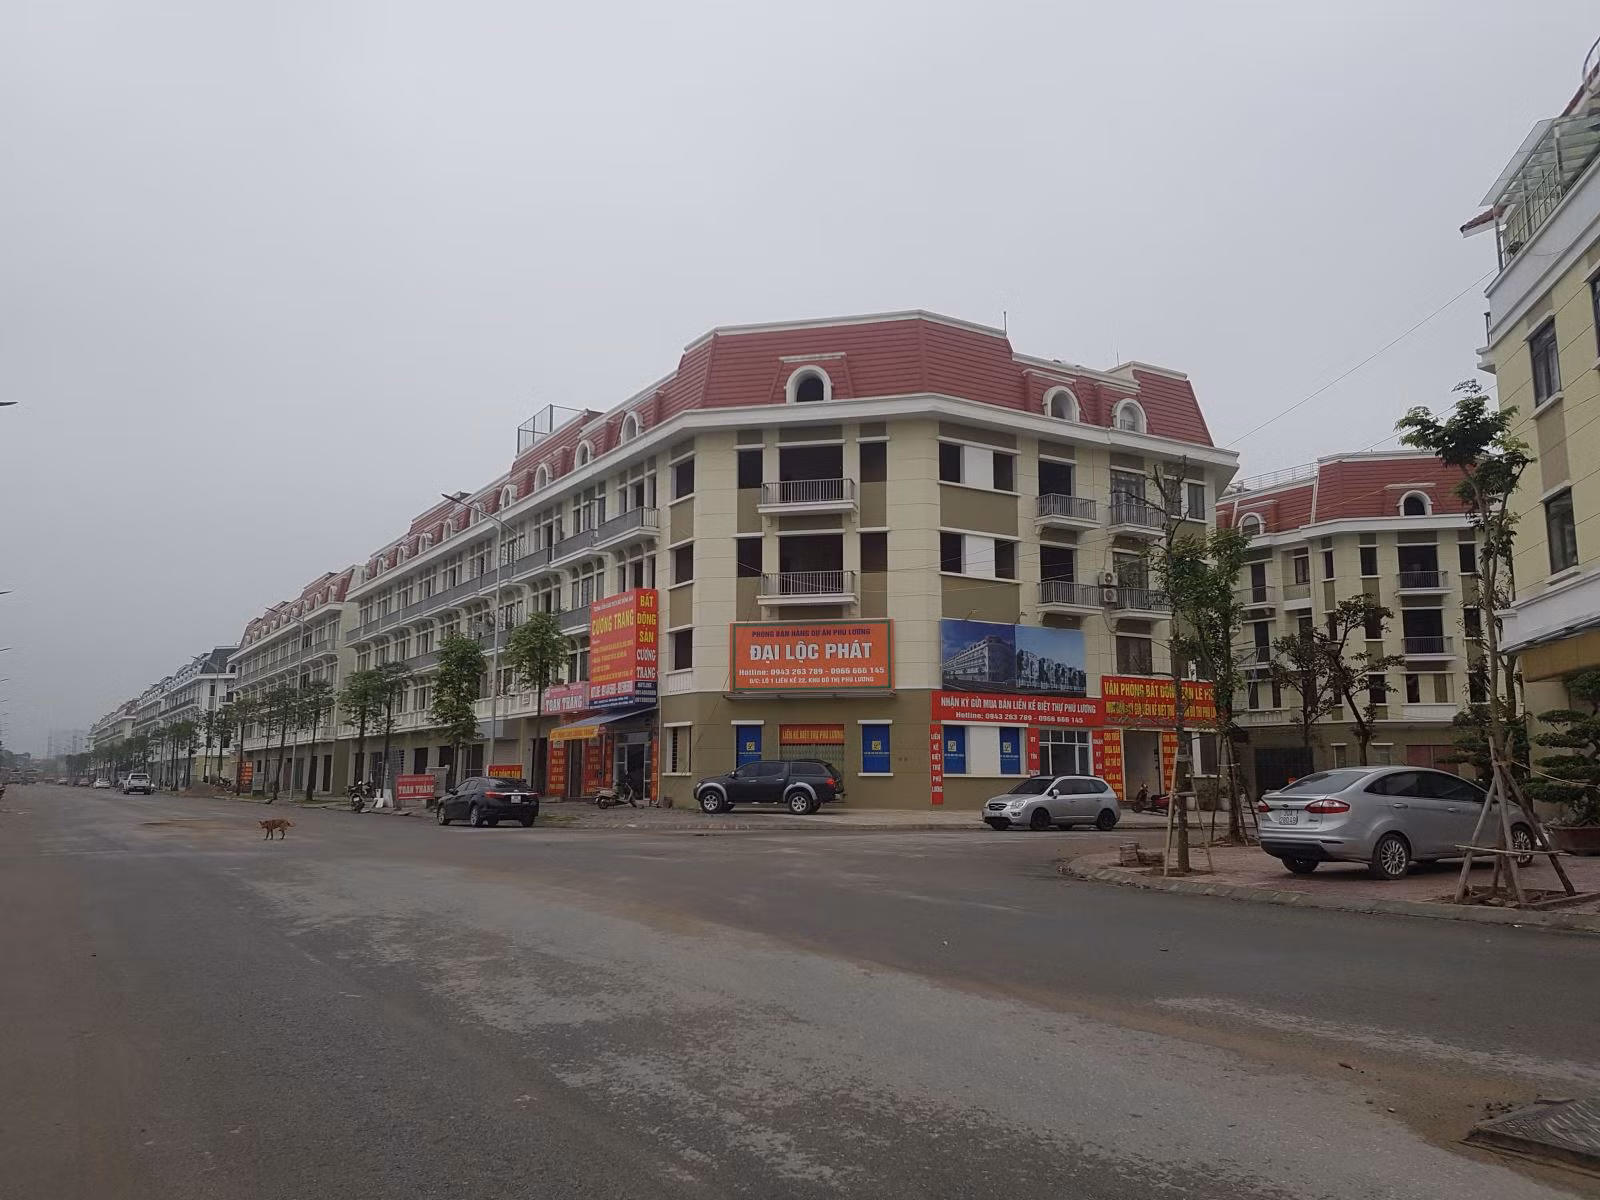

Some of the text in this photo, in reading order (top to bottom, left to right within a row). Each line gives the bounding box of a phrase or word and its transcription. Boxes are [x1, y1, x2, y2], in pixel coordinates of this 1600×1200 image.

[640, 592, 653, 607] BẤT
[614, 608, 634, 630] TRANG
[637, 610, 656, 627] ĐỘNG
[640, 627, 653, 642] SẢN
[750, 639, 873, 664] ĐẠI LỘC PHÁT
[636, 666, 655, 679] TRANG
[1104, 680, 1119, 695] VĂN
[1120, 681, 1144, 697] PHÒNG
[1145, 681, 1158, 697] BẤT
[941, 696, 959, 708] NHẬN
[999, 698, 1012, 709] BÁN
[1037, 701, 1050, 712] BIỆT
[1051, 702, 1063, 713] THỰ
[956, 711, 983, 719] Hotline:
